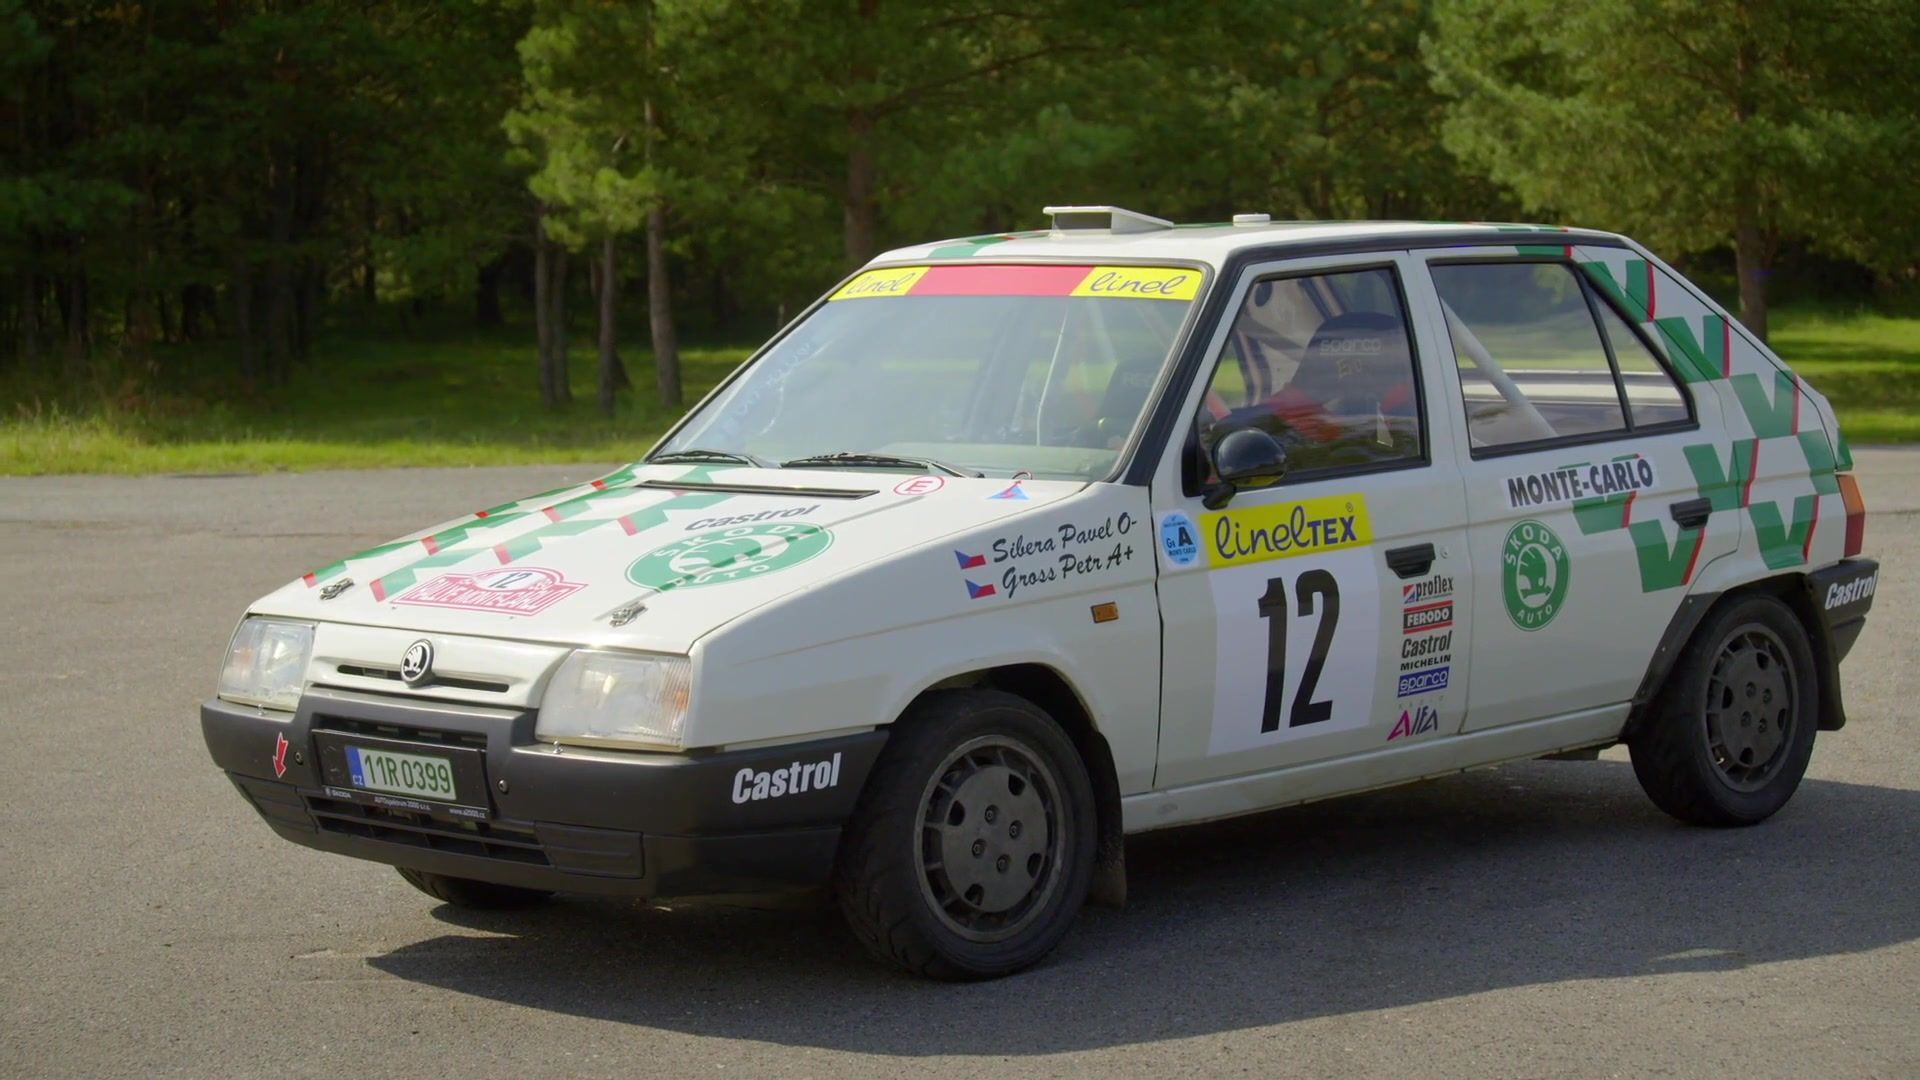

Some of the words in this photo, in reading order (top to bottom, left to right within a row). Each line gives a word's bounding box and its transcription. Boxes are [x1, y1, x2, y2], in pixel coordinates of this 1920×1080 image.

[846, 272, 916, 294] linel
[1090, 272, 1188, 295] linel
[904, 480, 934, 492] E
[1508, 459, 1654, 507] MONTE-CARLO
[685, 504, 822, 531] Castrol
[993, 535, 1056, 563] Sibera
[1058, 517, 1114, 548] Pavel
[1178, 526, 1194, 547] A
[488, 572, 534, 588] 12
[1002, 566, 1057, 599] Gross
[1059, 554, 1103, 579] Petr
[1416, 575, 1454, 602] proflex
[1825, 570, 1879, 610] Castrol
[1407, 608, 1450, 627] FERODO
[1517, 604, 1553, 624] AUTO
[1258, 569, 1340, 734] 12
[1402, 630, 1452, 659] Castrol
[1400, 654, 1451, 671] MICHELIN
[1400, 671, 1448, 693] sparco
[352, 774, 364, 786] CZ
[732, 751, 842, 804] Castrol
